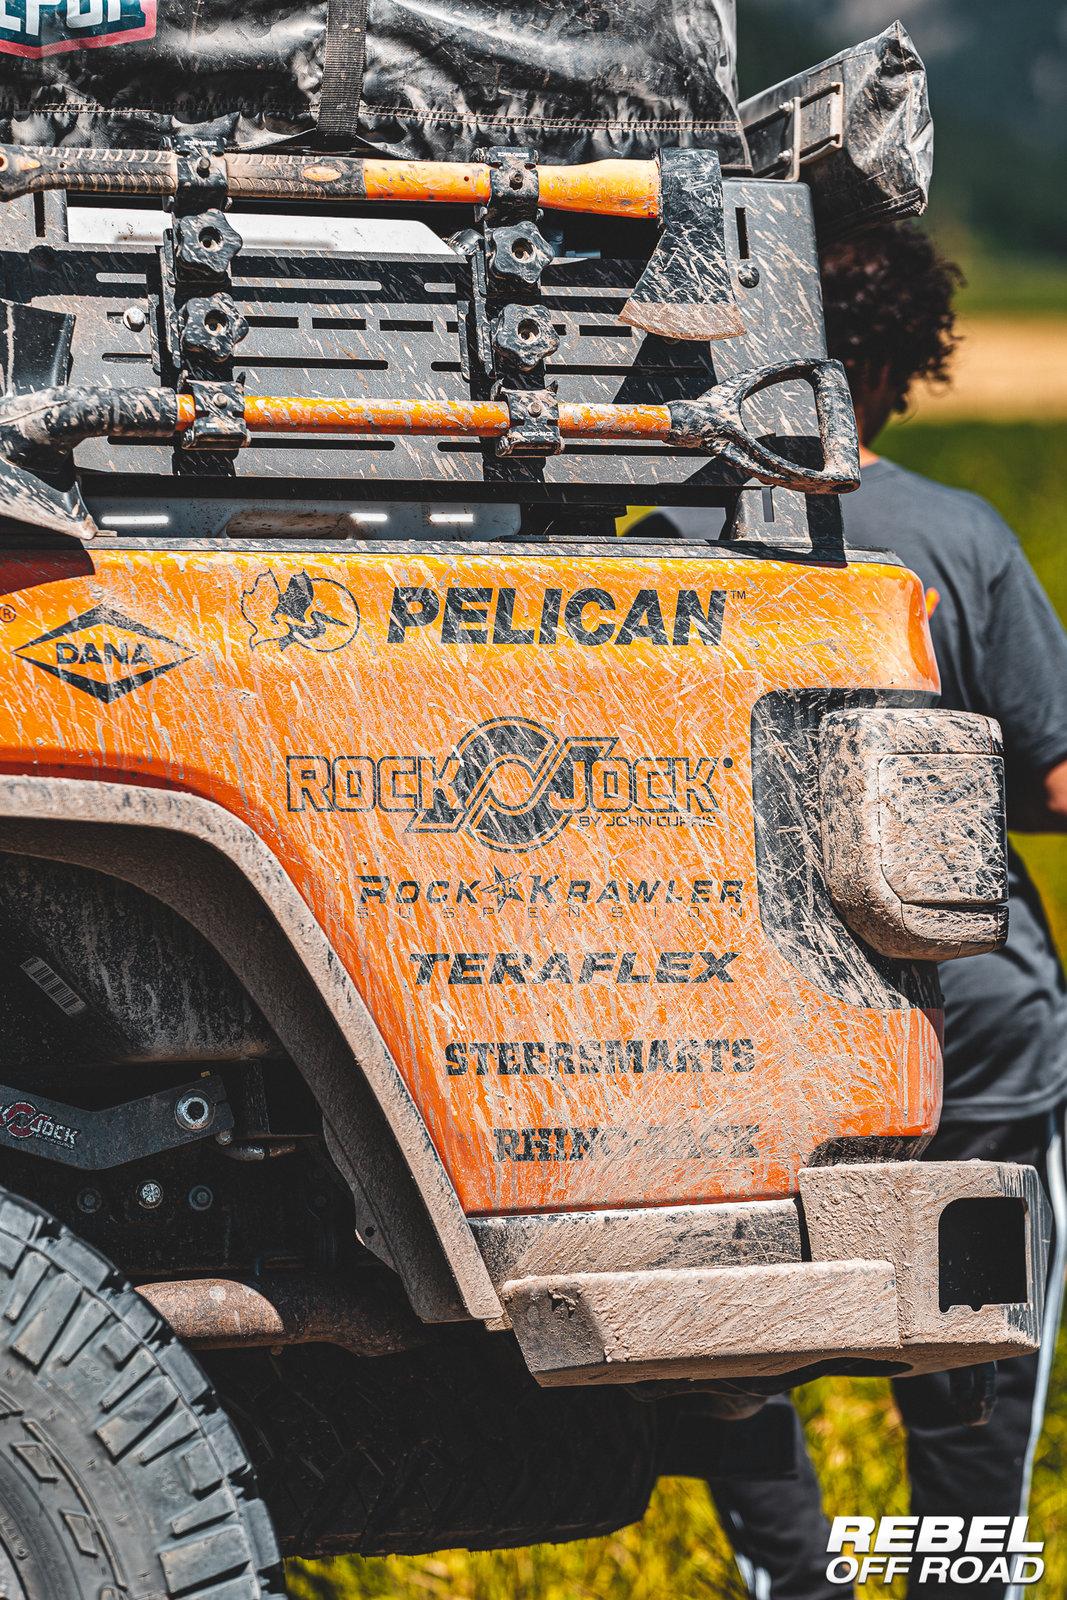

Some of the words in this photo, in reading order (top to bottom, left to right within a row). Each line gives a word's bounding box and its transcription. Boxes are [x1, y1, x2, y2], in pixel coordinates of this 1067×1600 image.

[386, 587, 727, 646] PELICAN
[55, 642, 156, 666] DANA
[286, 755, 469, 813] ROCK
[549, 754, 720, 814] JOCK
[579, 815, 601, 827] BY
[606, 815, 651, 827] JOHN
[354, 875, 479, 904] ROCK
[530, 874, 744, 905] KRAWLER
[409, 951, 743, 986] TERAFLEX
[445, 1038, 755, 1076] STEERSMARTS
